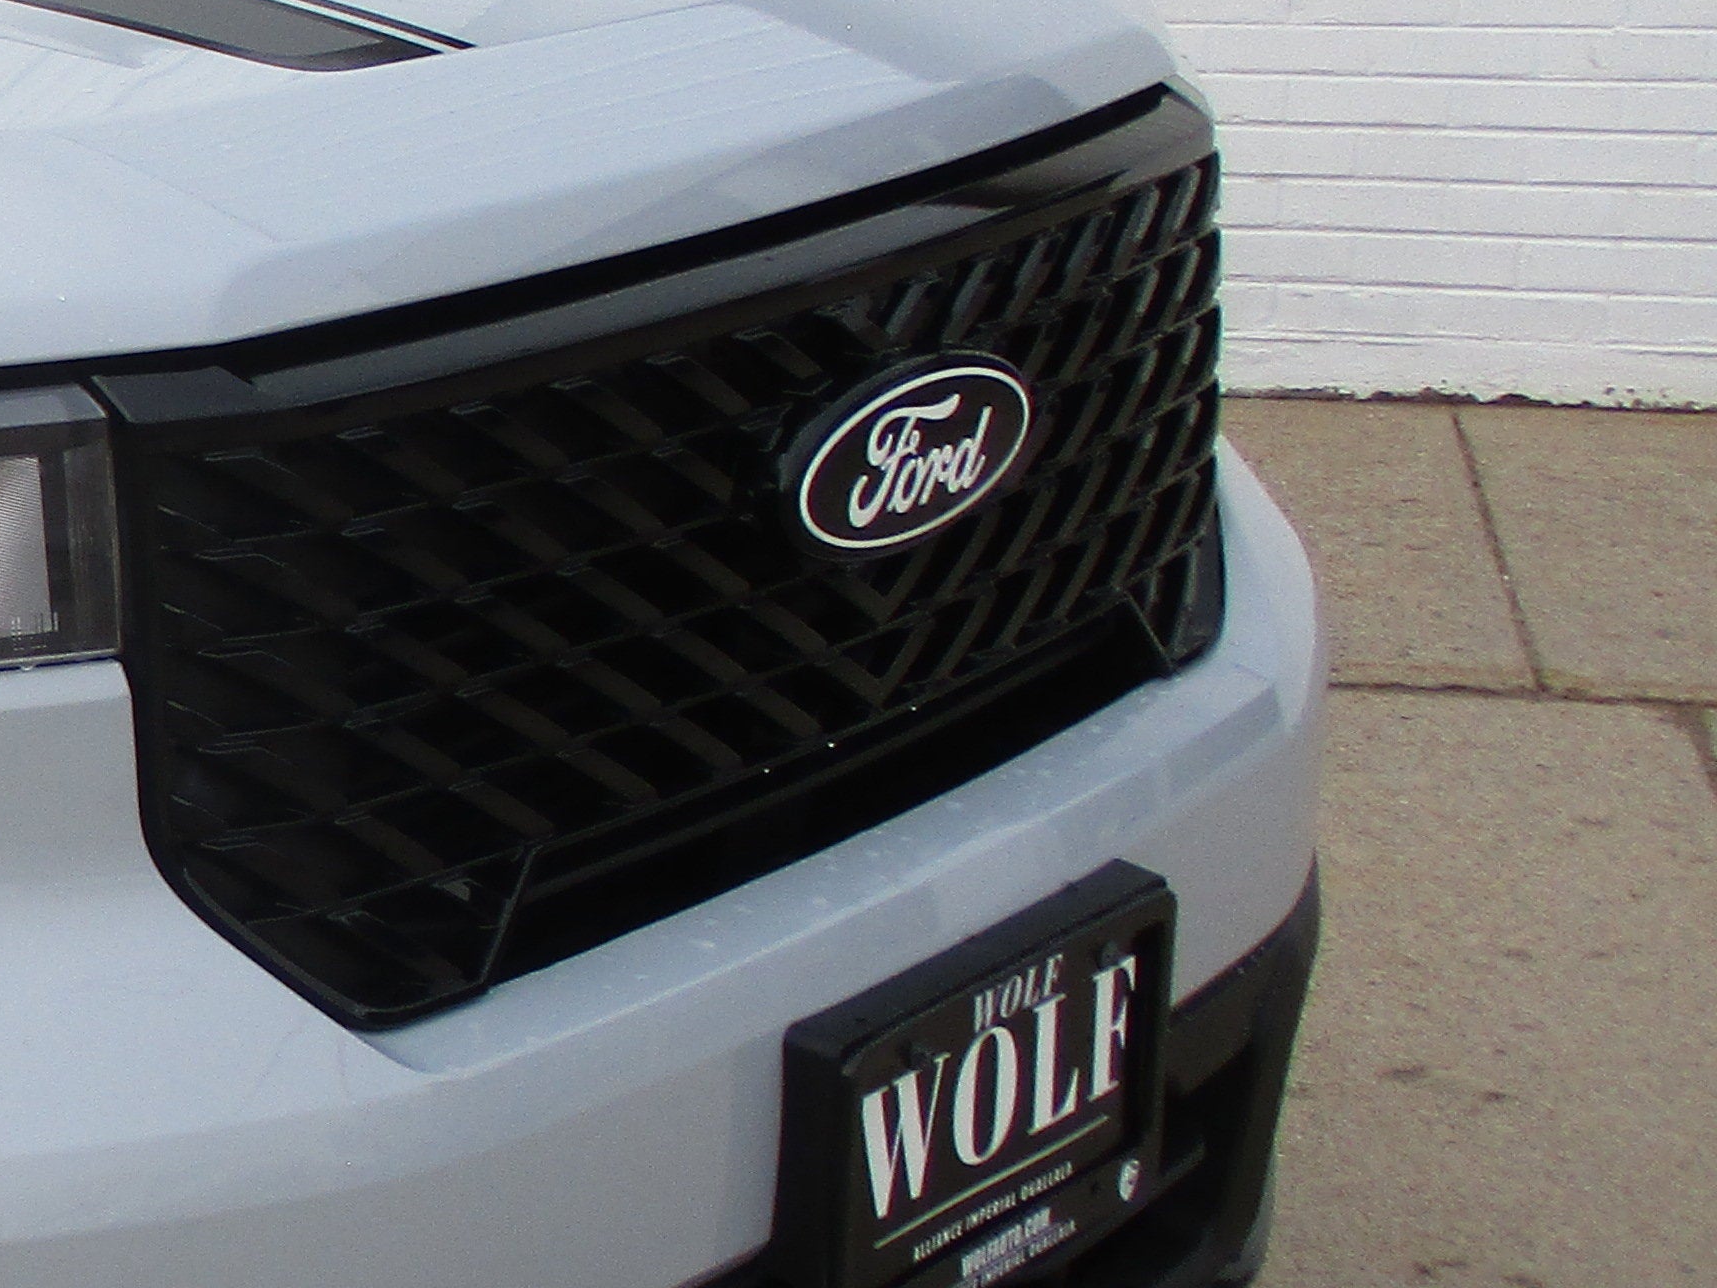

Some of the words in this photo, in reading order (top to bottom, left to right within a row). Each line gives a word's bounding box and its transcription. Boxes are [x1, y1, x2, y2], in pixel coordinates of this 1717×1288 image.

[848, 393, 993, 528] Ford
[973, 953, 1064, 1033] WOLF
[861, 954, 1137, 1220] WOLF
